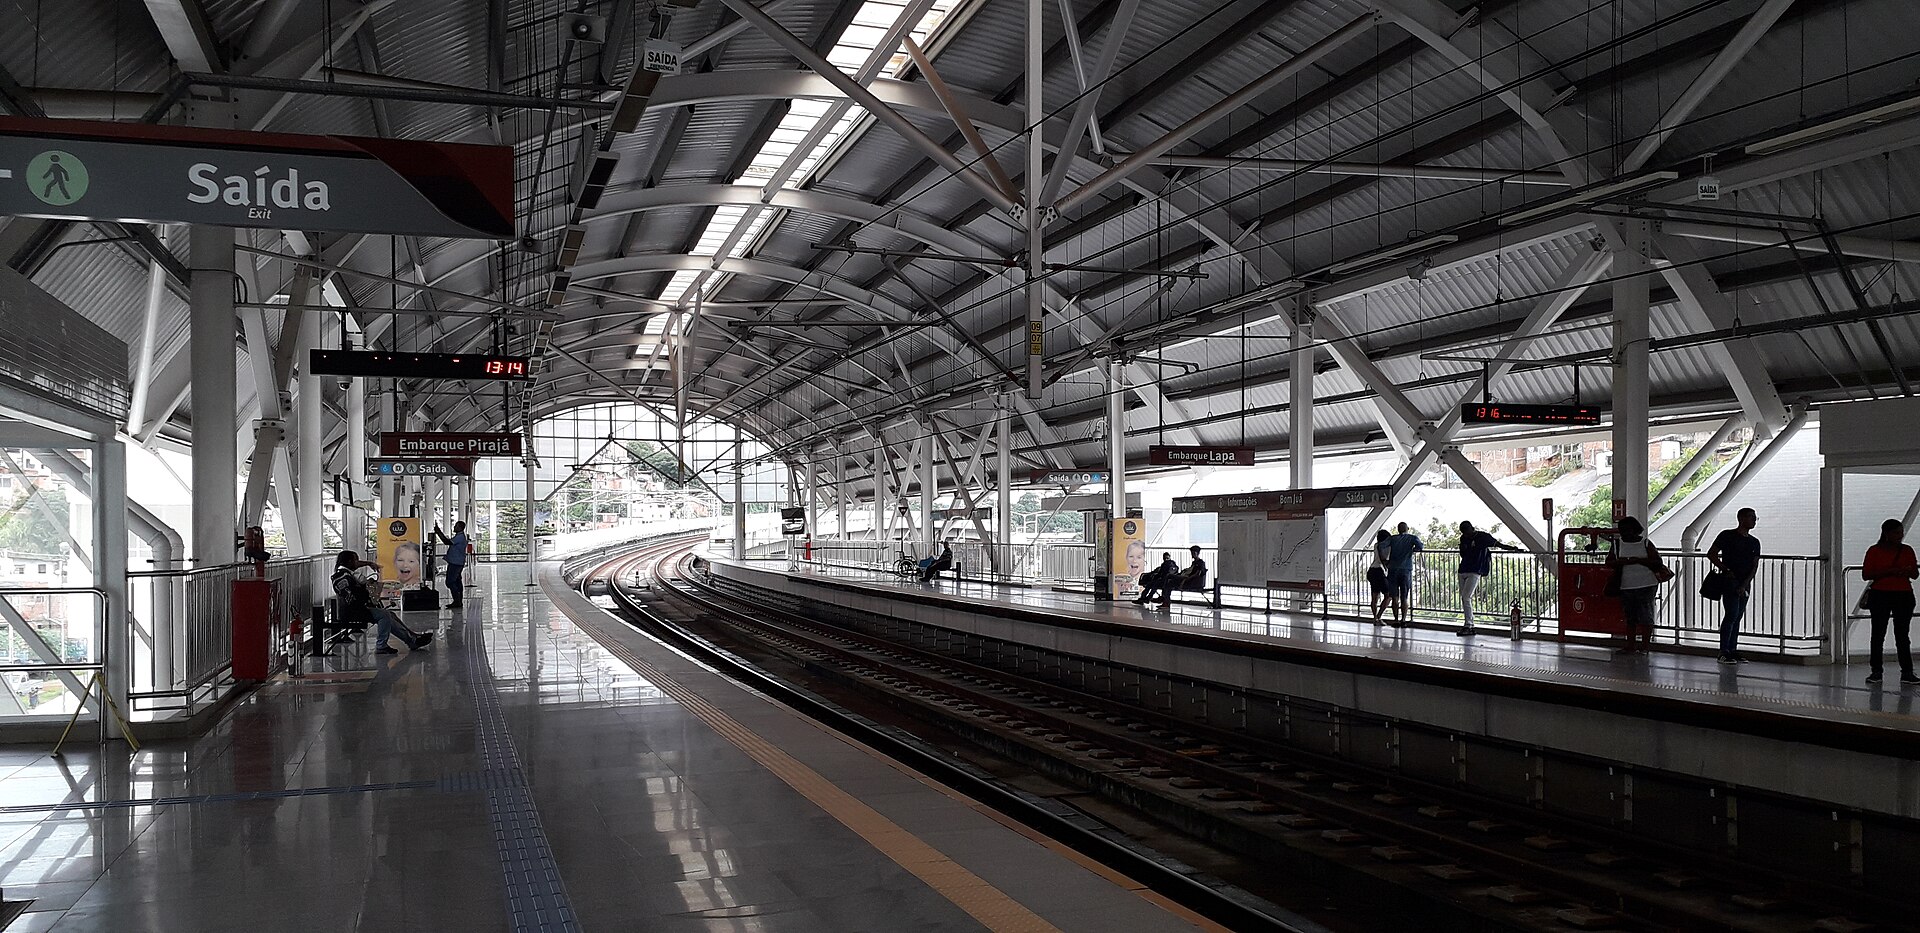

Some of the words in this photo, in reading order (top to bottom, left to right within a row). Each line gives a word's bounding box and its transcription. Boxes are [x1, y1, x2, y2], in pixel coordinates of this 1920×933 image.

[648, 51, 677, 66] SAÍDA
[187, 162, 331, 211] Saída
[1700, 184, 1717, 194] SAÍDA
[248, 207, 272, 220] Exit
[1032, 322, 1040, 331] 09
[1032, 333, 1041, 342] 07
[486, 361, 523, 374] 13:14
[400, 438, 465, 453] Embarque
[468, 438, 510, 454] Pirajá
[1168, 451, 1208, 462] Embarque
[1209, 450, 1235, 464] Lapa
[419, 464, 447, 473] Saída
[1048, 474, 1070, 482] Saída
[1280, 494, 1293, 504] Bom
[1346, 492, 1364, 503] Saída
[1614, 503, 1624, 517] H
